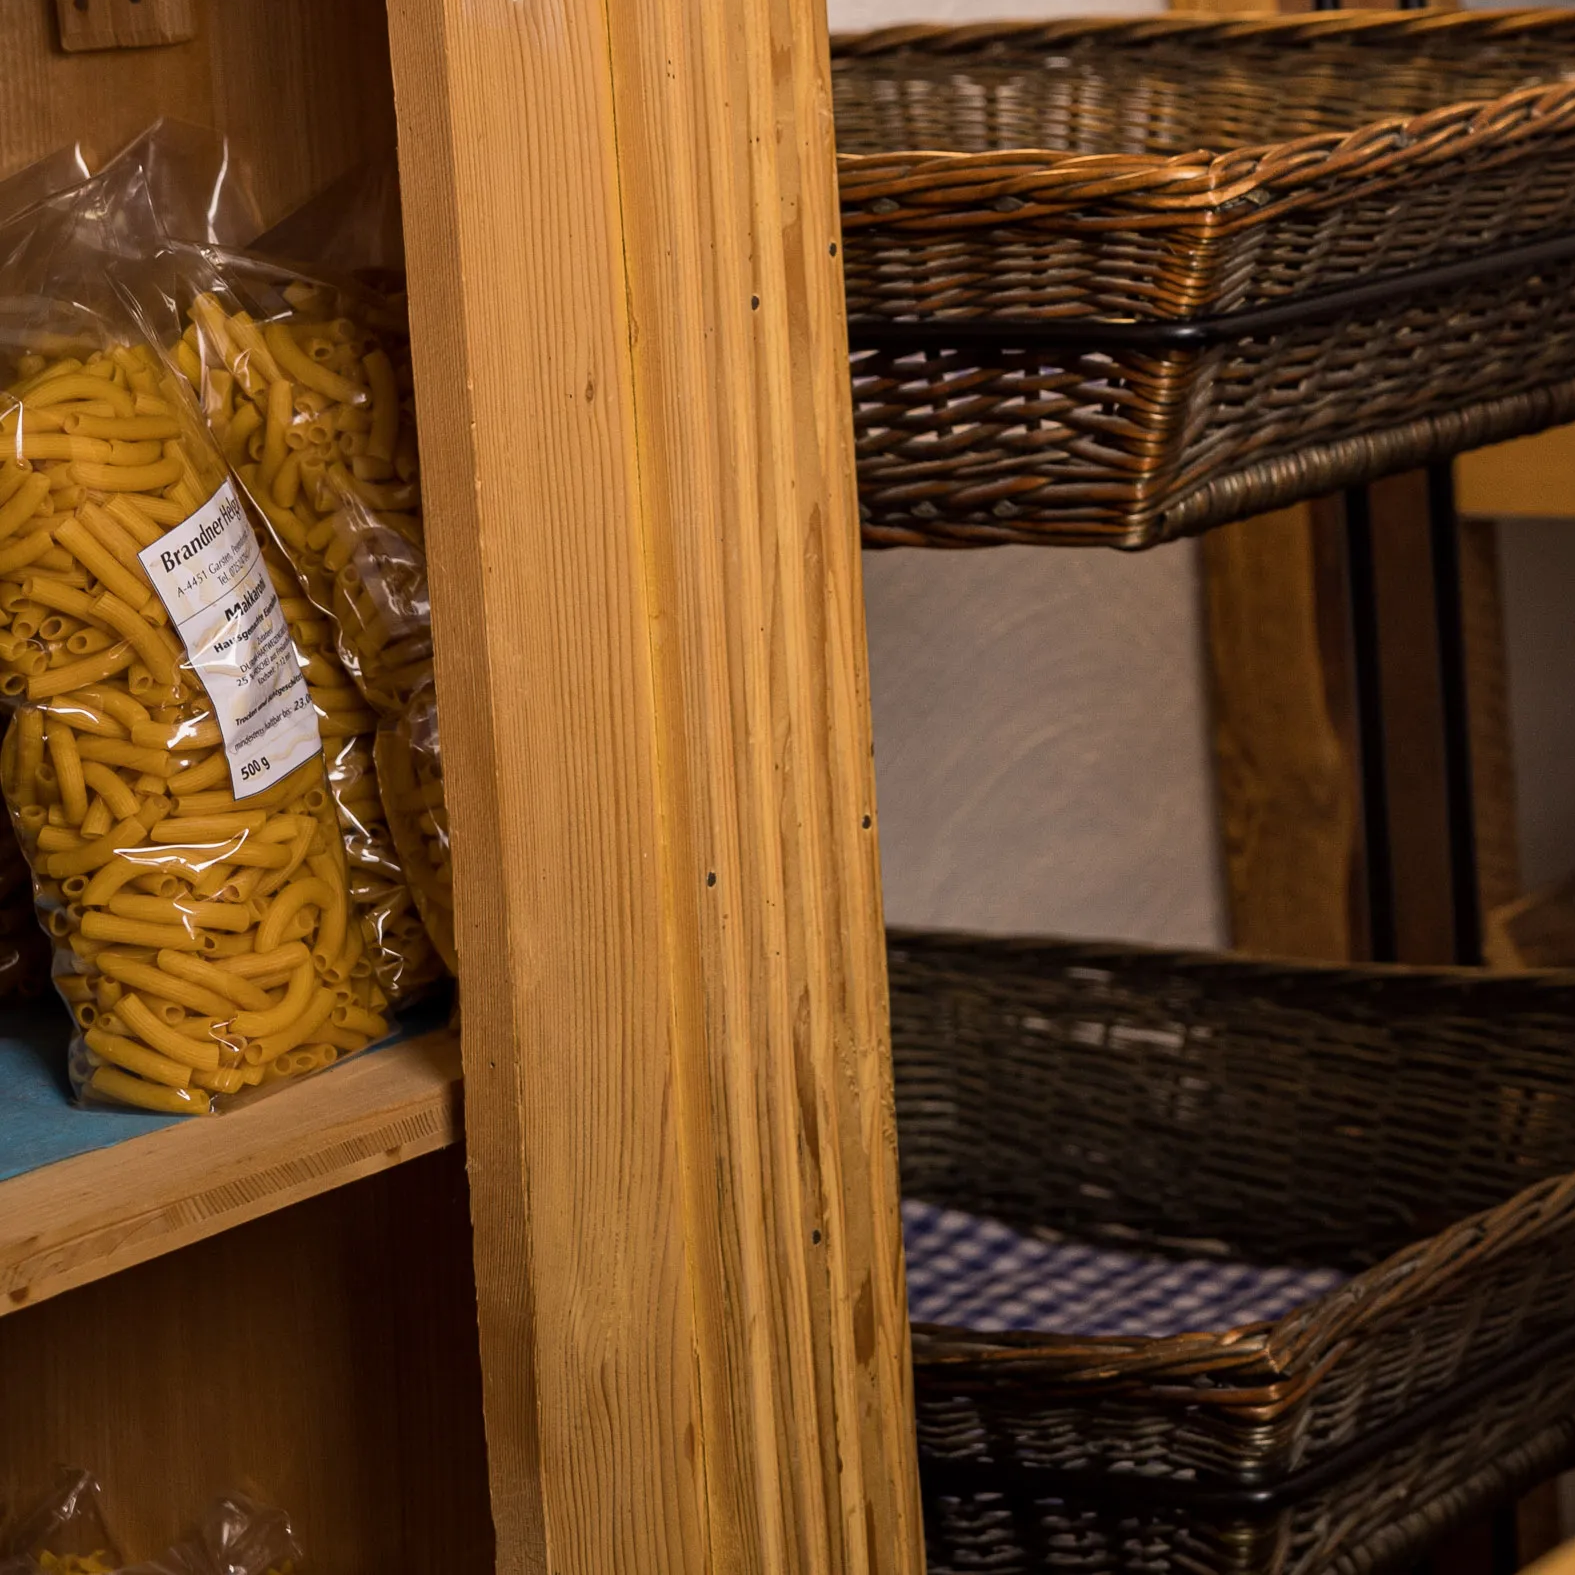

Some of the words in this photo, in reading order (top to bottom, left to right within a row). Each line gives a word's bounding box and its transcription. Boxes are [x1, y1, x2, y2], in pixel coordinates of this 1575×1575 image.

[160, 515, 225, 574] Brandner
[219, 496, 242, 526] Helg
[177, 570, 208, 598] A-4451
[240, 759, 262, 781] 500
[260, 756, 271, 770] g
